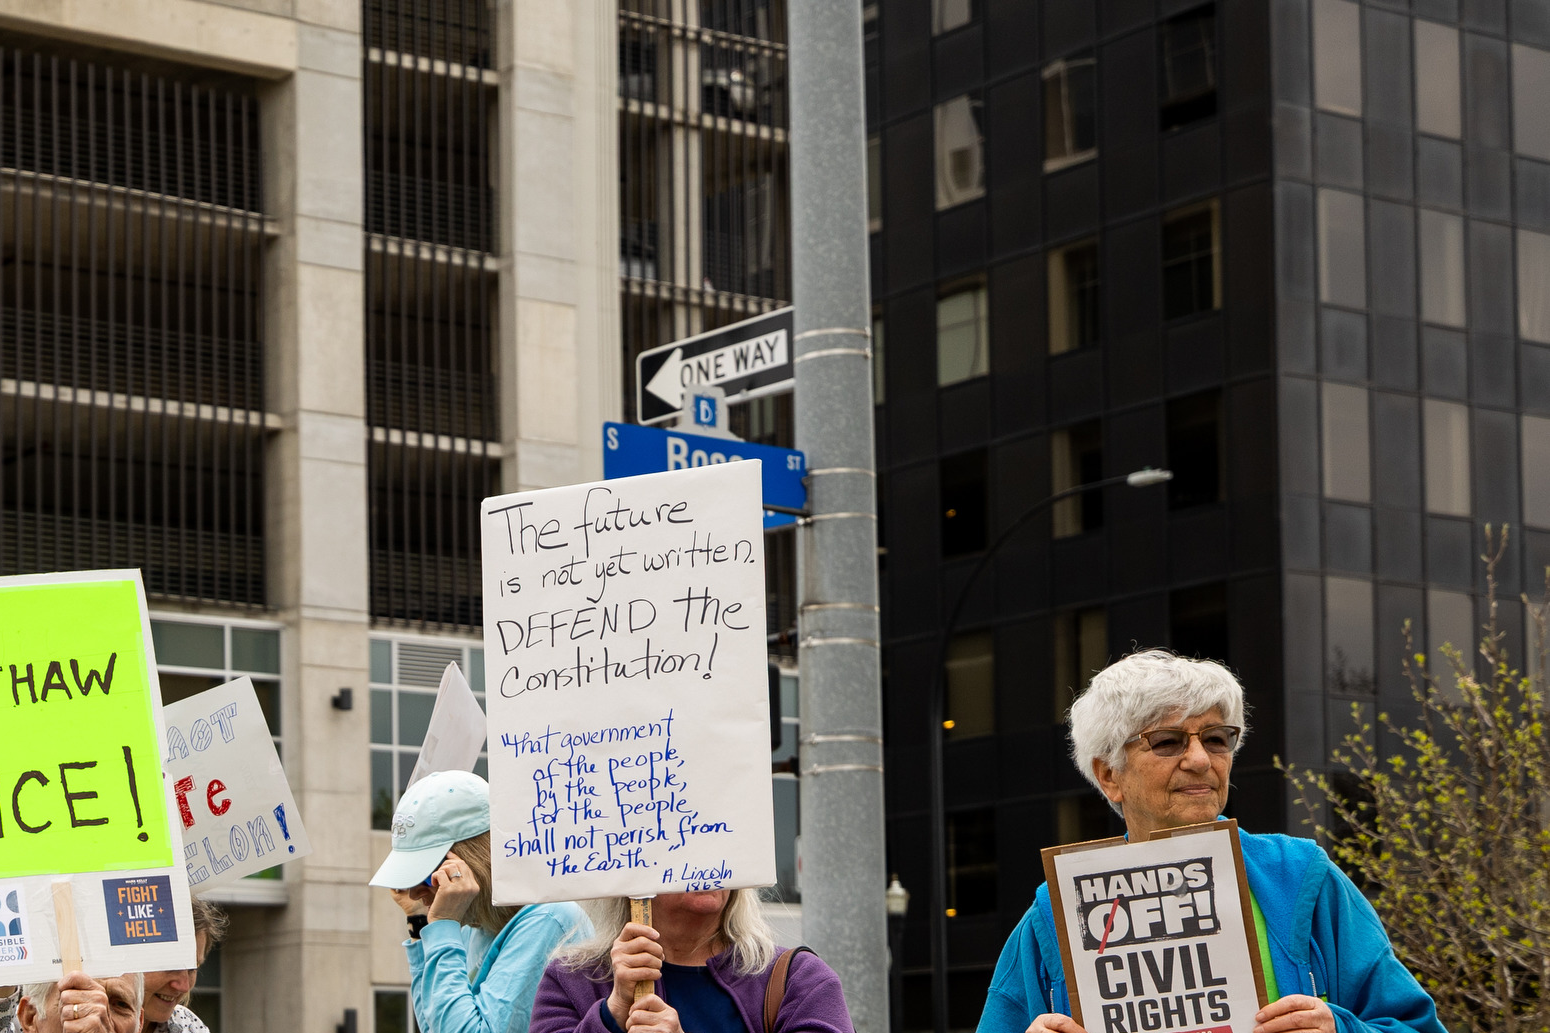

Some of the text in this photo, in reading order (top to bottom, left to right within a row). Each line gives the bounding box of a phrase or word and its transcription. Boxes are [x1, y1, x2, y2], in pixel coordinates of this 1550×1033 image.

[680, 335, 779, 389] ONE WAY
[606, 426, 619, 450] S
[786, 454, 801, 471] ST
[488, 487, 694, 558] The future
[500, 531, 756, 604] is not yet written.
[497, 598, 657, 655] DEFEND
[500, 632, 719, 698] Constitution!
[560, 708, 674, 759] government
[533, 738, 685, 788] of the people,
[527, 791, 699, 837] for the people,
[536, 767, 687, 814] by the people,
[504, 815, 734, 862] shall not perish from
[547, 855, 580, 877] the
[662, 859, 733, 884] A. Lincoln
[1080, 862, 1208, 903] HANDS
[117, 885, 158, 904] FIGHT
[127, 904, 154, 919] LIKE
[1087, 891, 1213, 944] OFF!
[125, 919, 162, 938] HELL
[1094, 942, 1228, 1001] CIVIL
